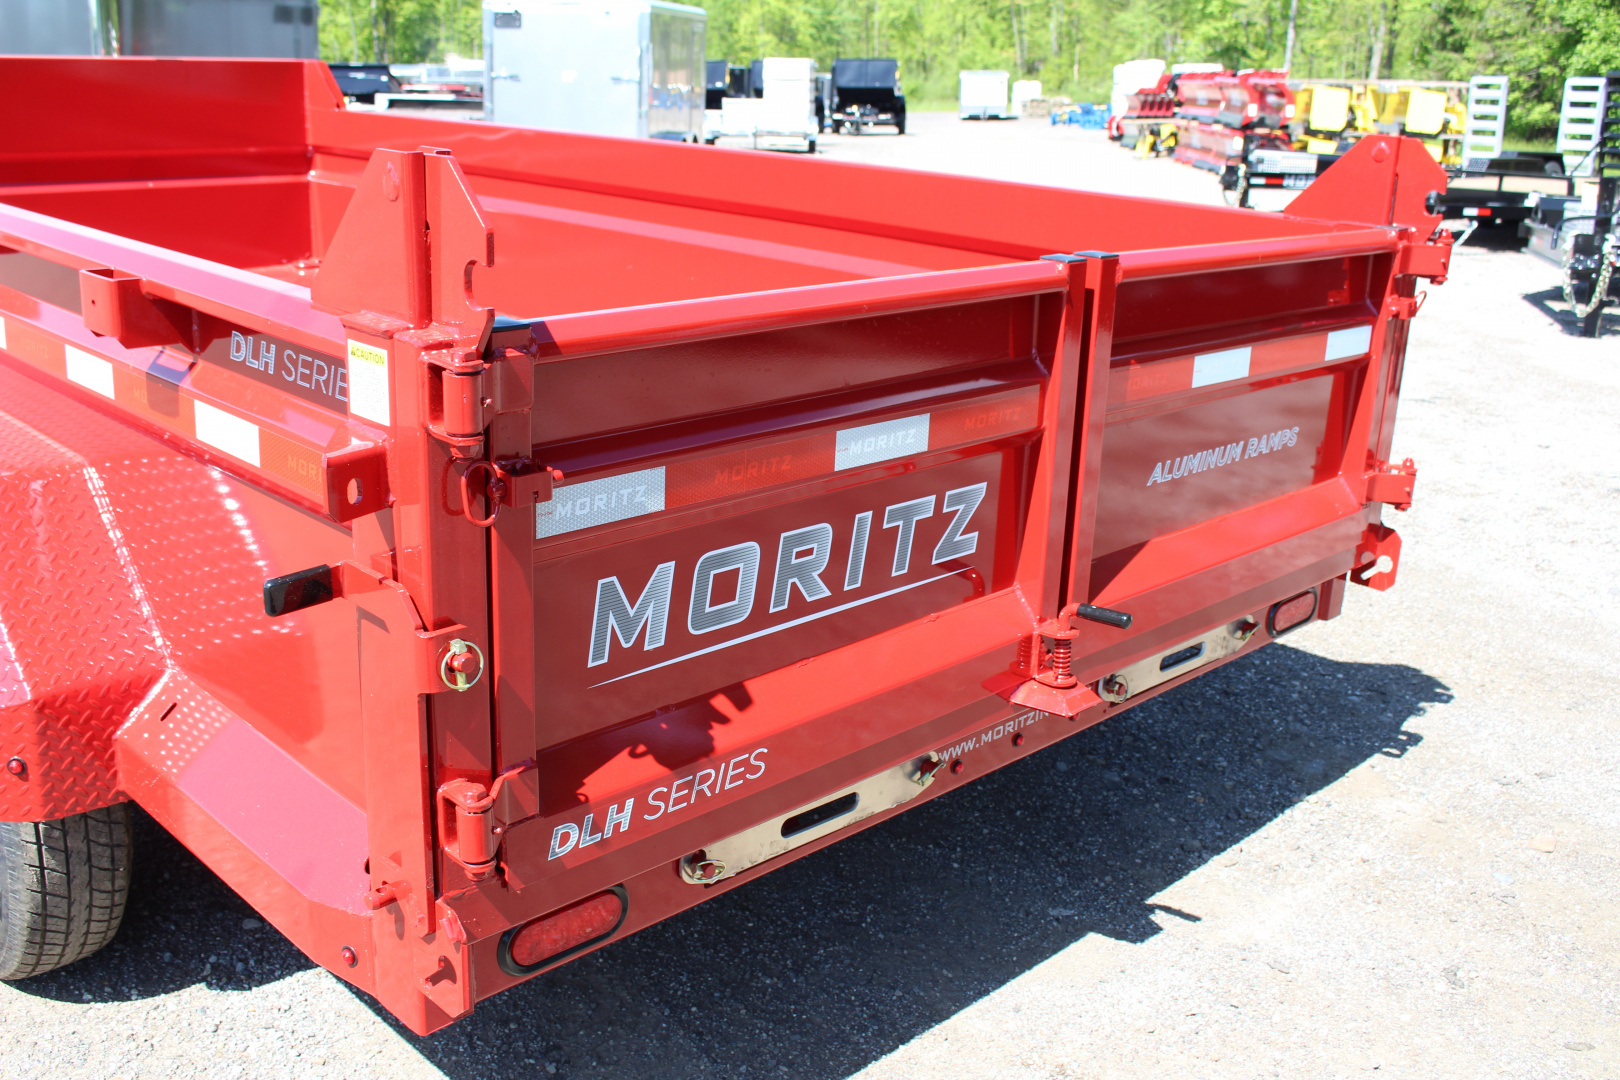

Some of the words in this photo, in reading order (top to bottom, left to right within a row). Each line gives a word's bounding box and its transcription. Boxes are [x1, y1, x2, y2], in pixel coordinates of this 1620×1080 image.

[230, 330, 276, 375] DLH
[281, 349, 349, 402] SERIE
[355, 348, 386, 366] CAUTION
[963, 406, 1024, 432] MORITZ
[849, 428, 918, 456] MORITZ
[1147, 440, 1245, 486] ALUMINUM
[1244, 426, 1300, 460] RAMPS
[714, 454, 793, 486] MORITZ
[556, 485, 648, 521] MORITZ
[587, 481, 989, 668] MORITZ
[548, 797, 635, 861] DLH
[643, 747, 769, 821] SERIES
